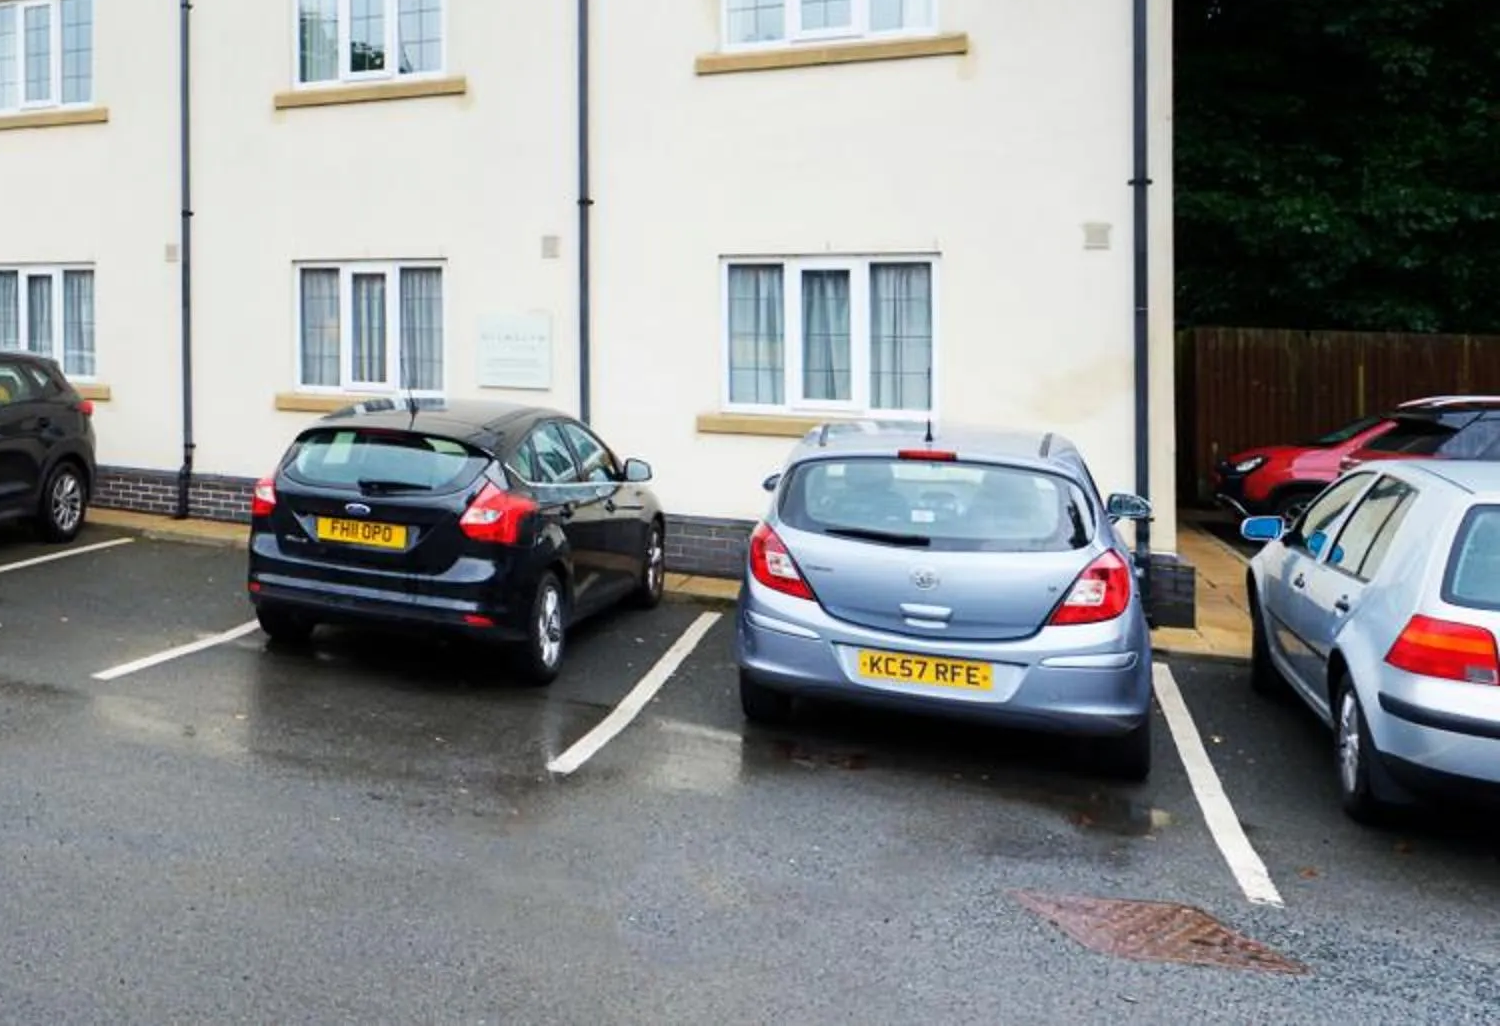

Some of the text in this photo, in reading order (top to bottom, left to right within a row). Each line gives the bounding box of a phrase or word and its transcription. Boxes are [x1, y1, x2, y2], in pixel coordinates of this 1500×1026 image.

[361, 523, 393, 543] OPO
[868, 655, 981, 686] KC57 RFE
